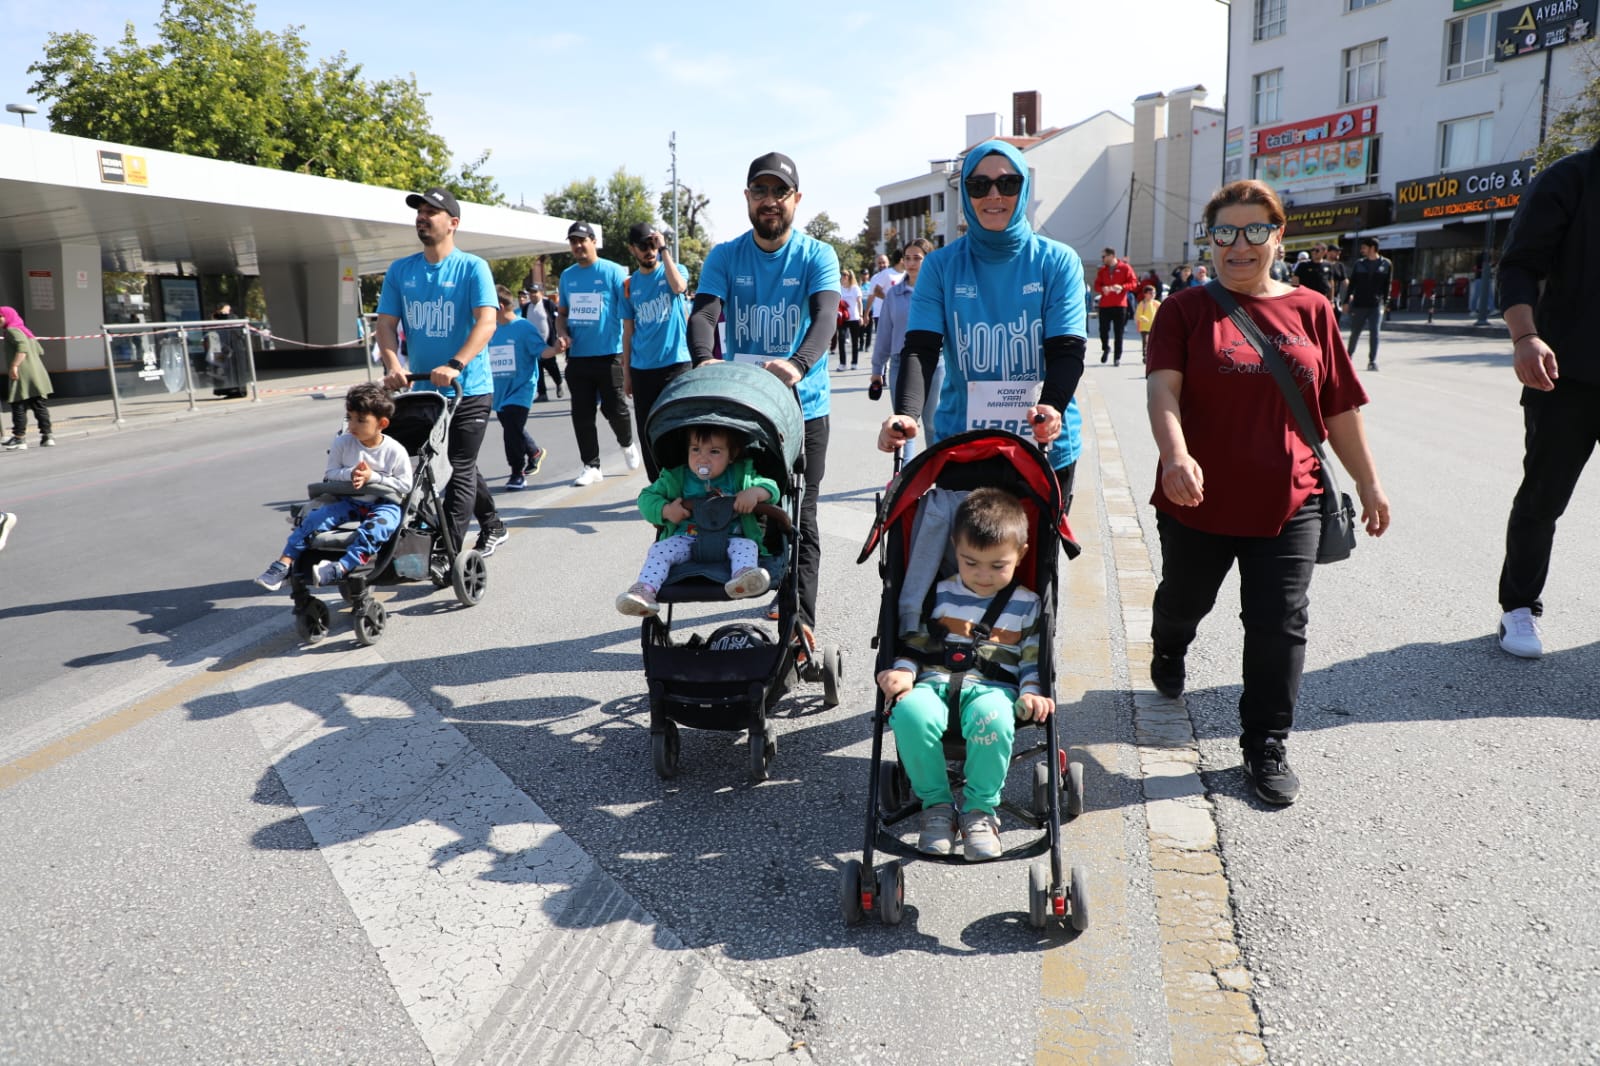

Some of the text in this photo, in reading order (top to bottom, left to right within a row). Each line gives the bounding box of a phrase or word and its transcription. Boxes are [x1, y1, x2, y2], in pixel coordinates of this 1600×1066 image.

[1537, 0, 1579, 20] AYBARS
[1400, 176, 1458, 204] KÜLTÜR
[1466, 171, 1505, 193] Cafe
[1510, 169, 1522, 187] &
[1423, 206, 1443, 217] KUZU
[1445, 200, 1484, 213] KOKOREÇ
[571, 306, 597, 314] 44902
